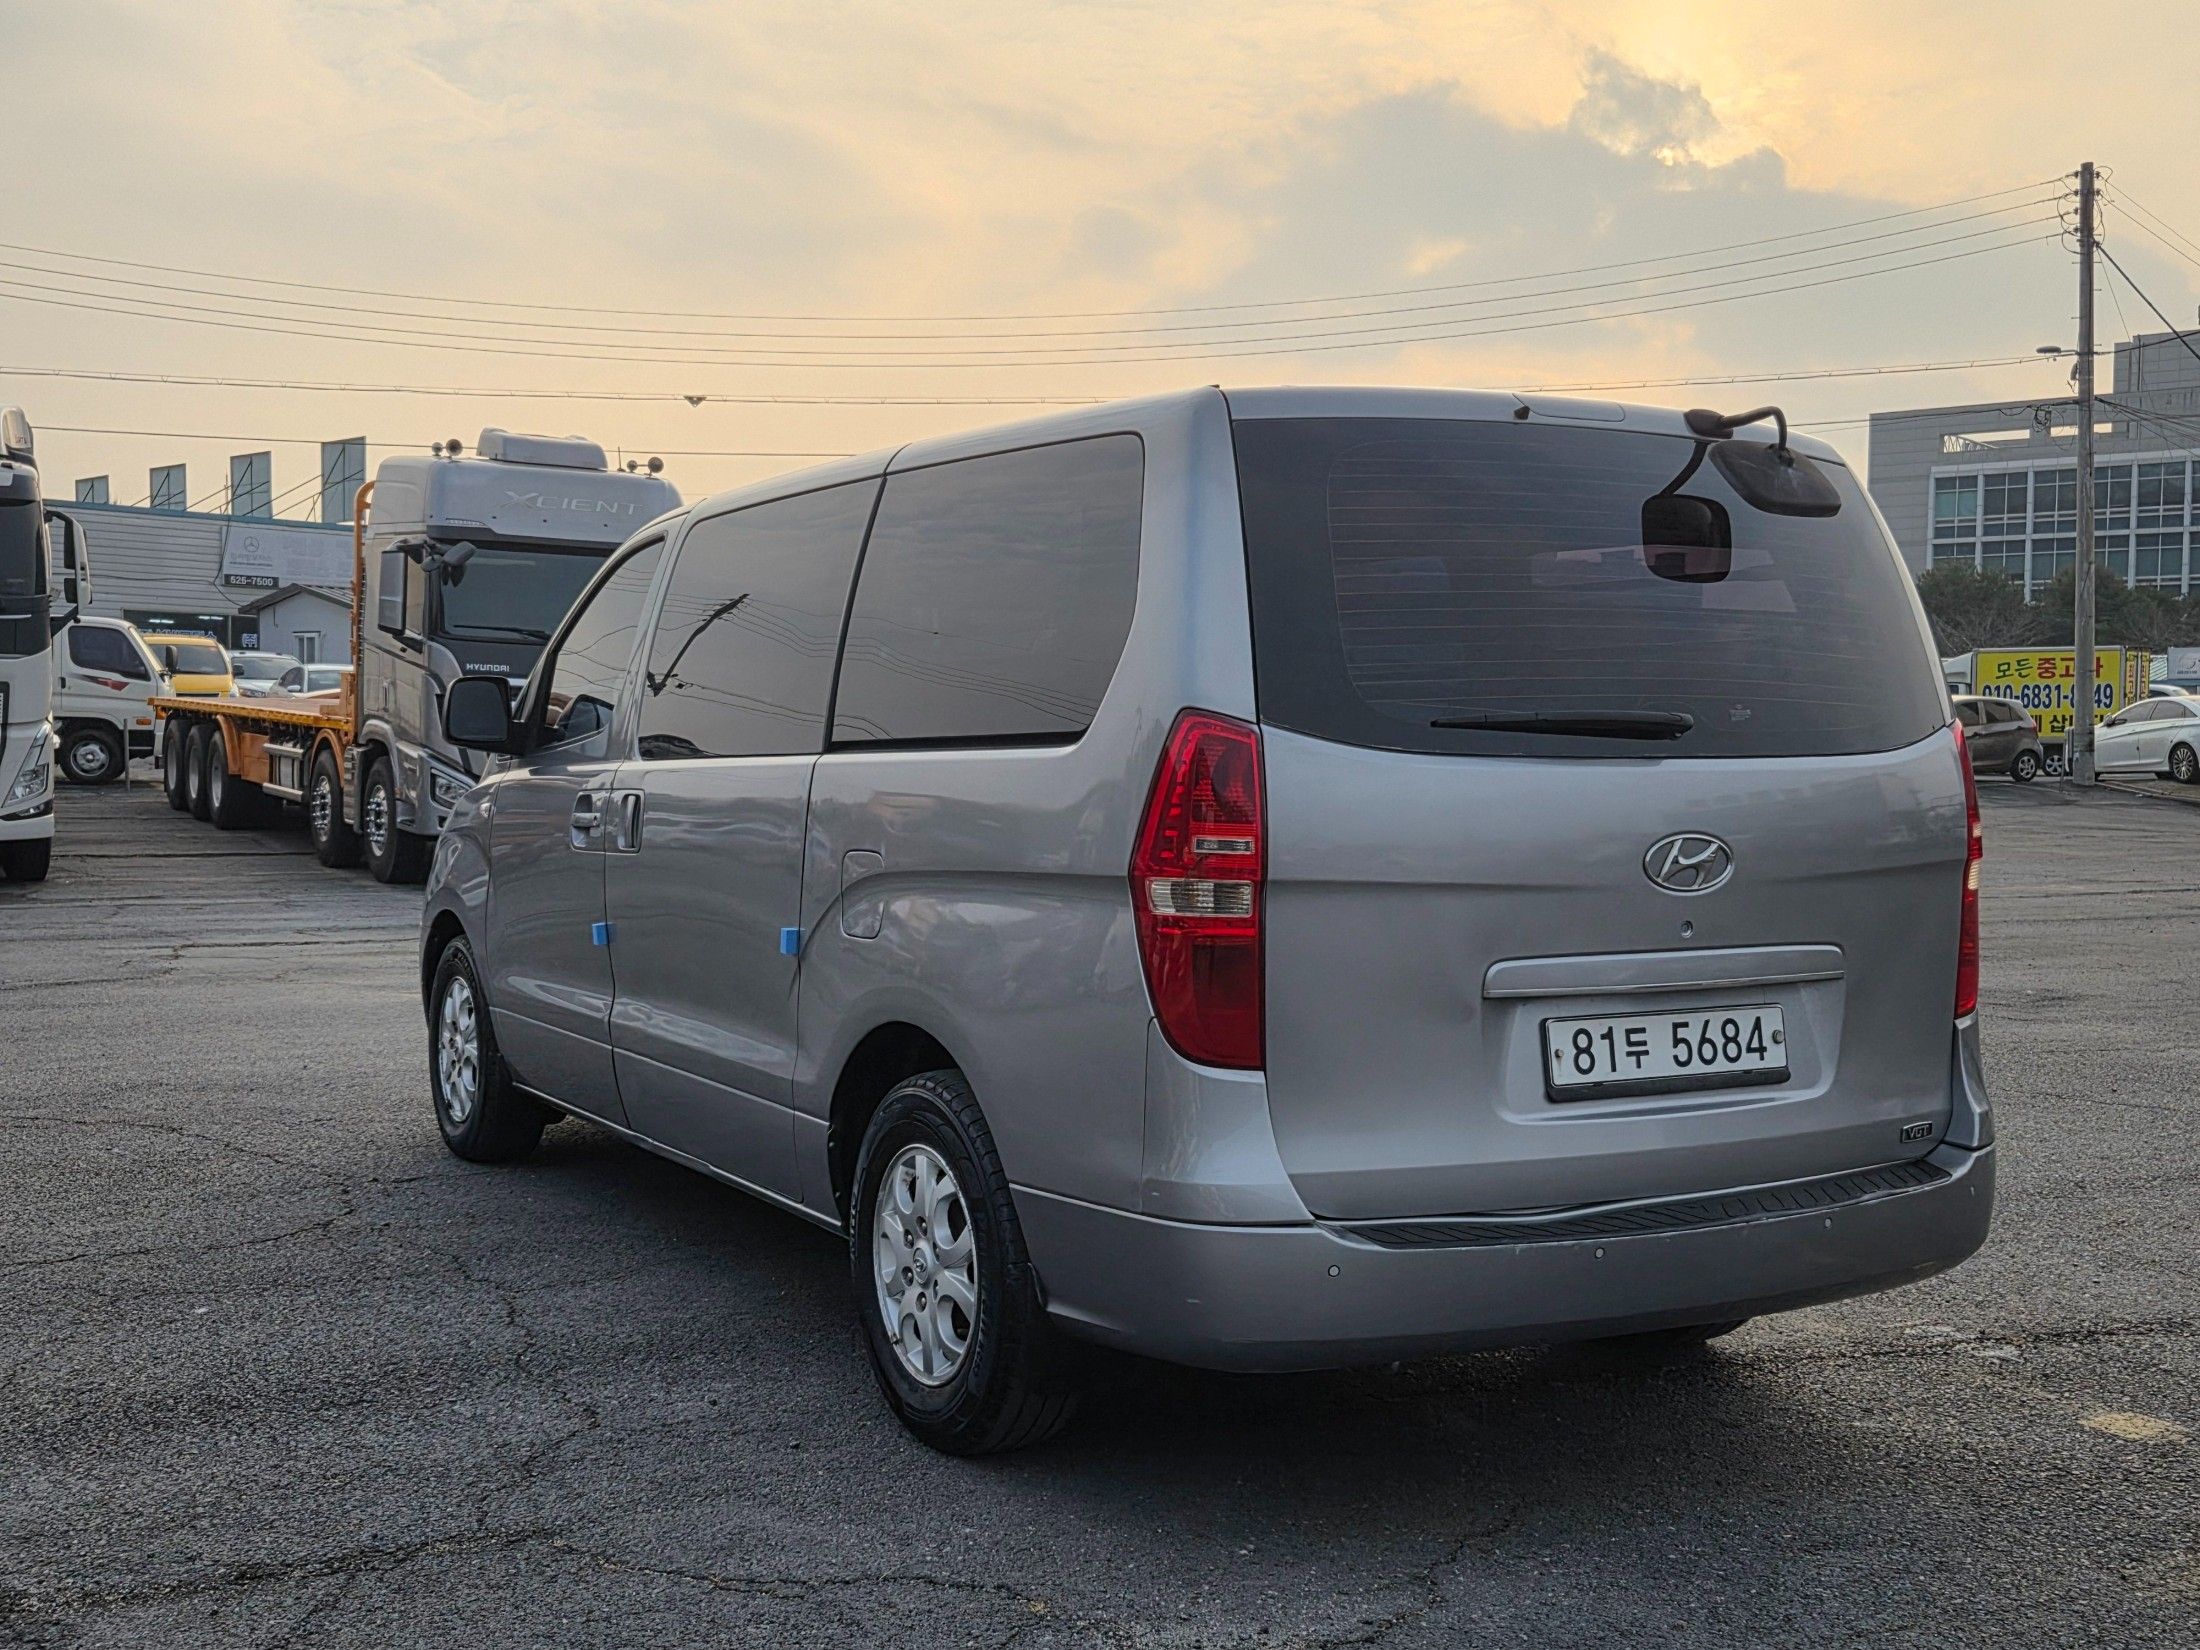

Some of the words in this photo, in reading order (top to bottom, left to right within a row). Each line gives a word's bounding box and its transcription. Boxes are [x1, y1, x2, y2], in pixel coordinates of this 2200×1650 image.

[501, 490, 643, 516] XCIENT
[466, 663, 510, 672] HYUNDAI
[1995, 657, 2033, 680] 모든
[1572, 1026, 1650, 1076] 81두
[1671, 1016, 1768, 1068] 5684
